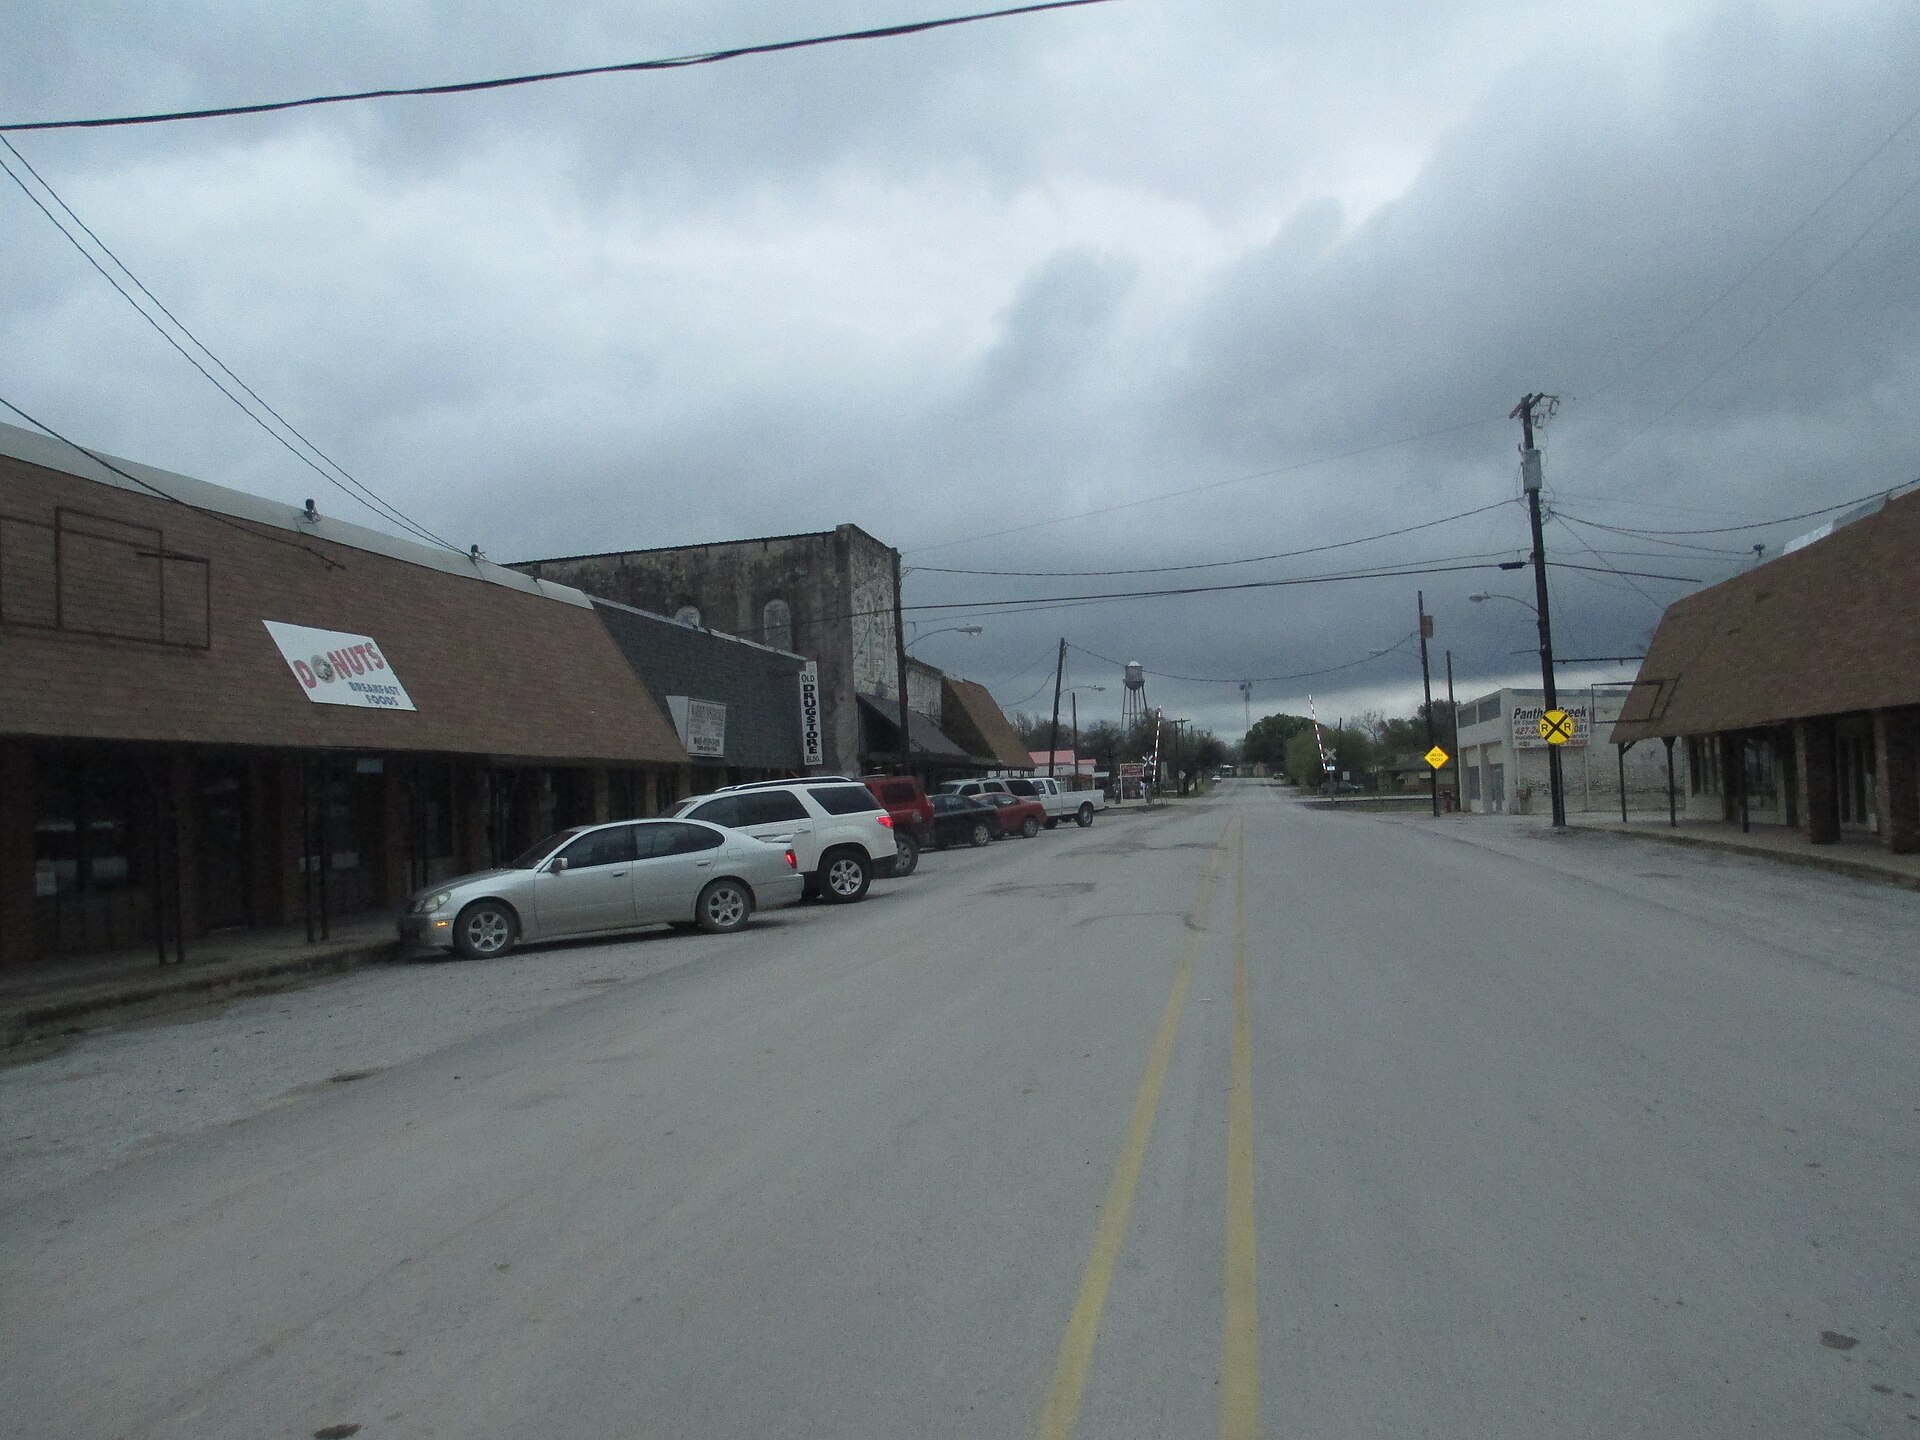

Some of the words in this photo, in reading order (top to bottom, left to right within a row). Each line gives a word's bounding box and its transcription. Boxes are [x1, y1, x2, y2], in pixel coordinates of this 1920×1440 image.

[293, 642, 384, 689] DONUTS
[801, 674, 815, 682] OLD
[348, 681, 400, 696] BREAKFAST
[365, 694, 399, 706] FOODS
[803, 684, 818, 754] DRUGSTORE
[1513, 707, 1543, 719] Panth
[1541, 724, 1548, 732] R
[1564, 722, 1571, 731] R
